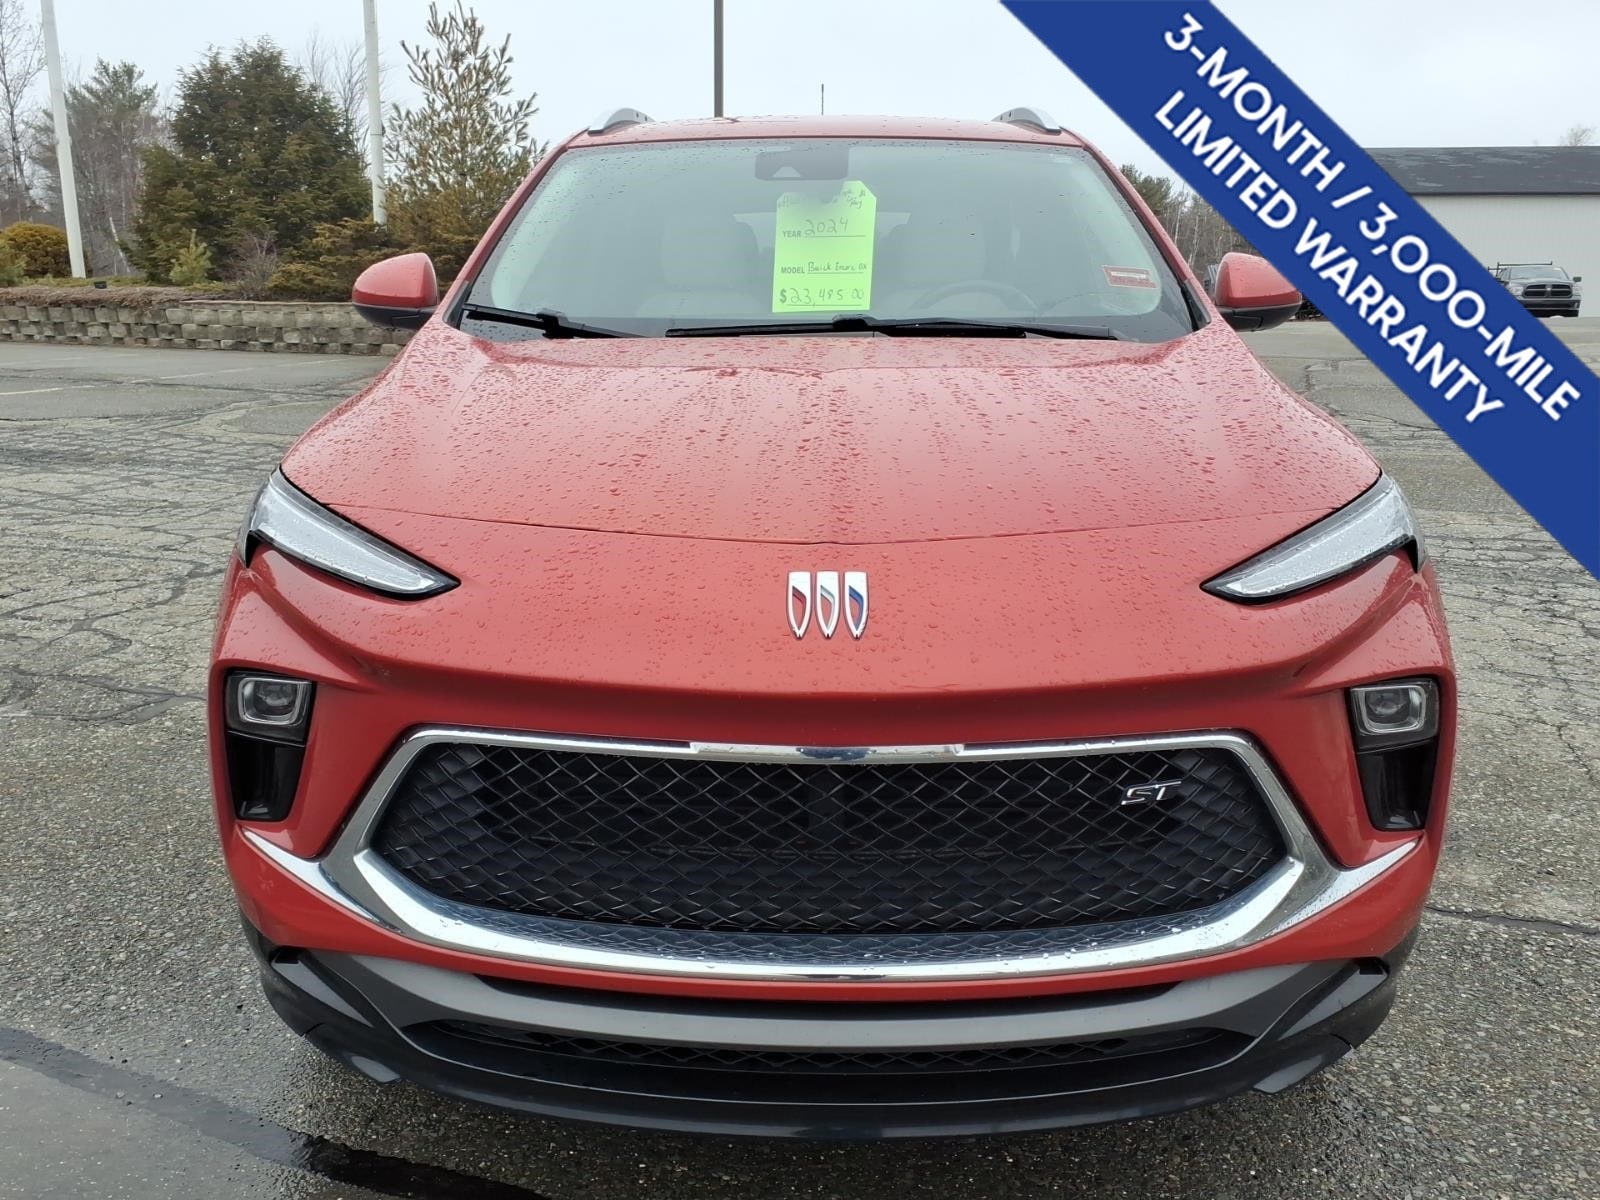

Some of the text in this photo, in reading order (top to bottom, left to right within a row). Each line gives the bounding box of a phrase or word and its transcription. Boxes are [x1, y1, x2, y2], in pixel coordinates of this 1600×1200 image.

[782, 217, 849, 238] YEAR 2024
[781, 266, 805, 274] MODEL
[1121, 780, 1181, 805] ST
